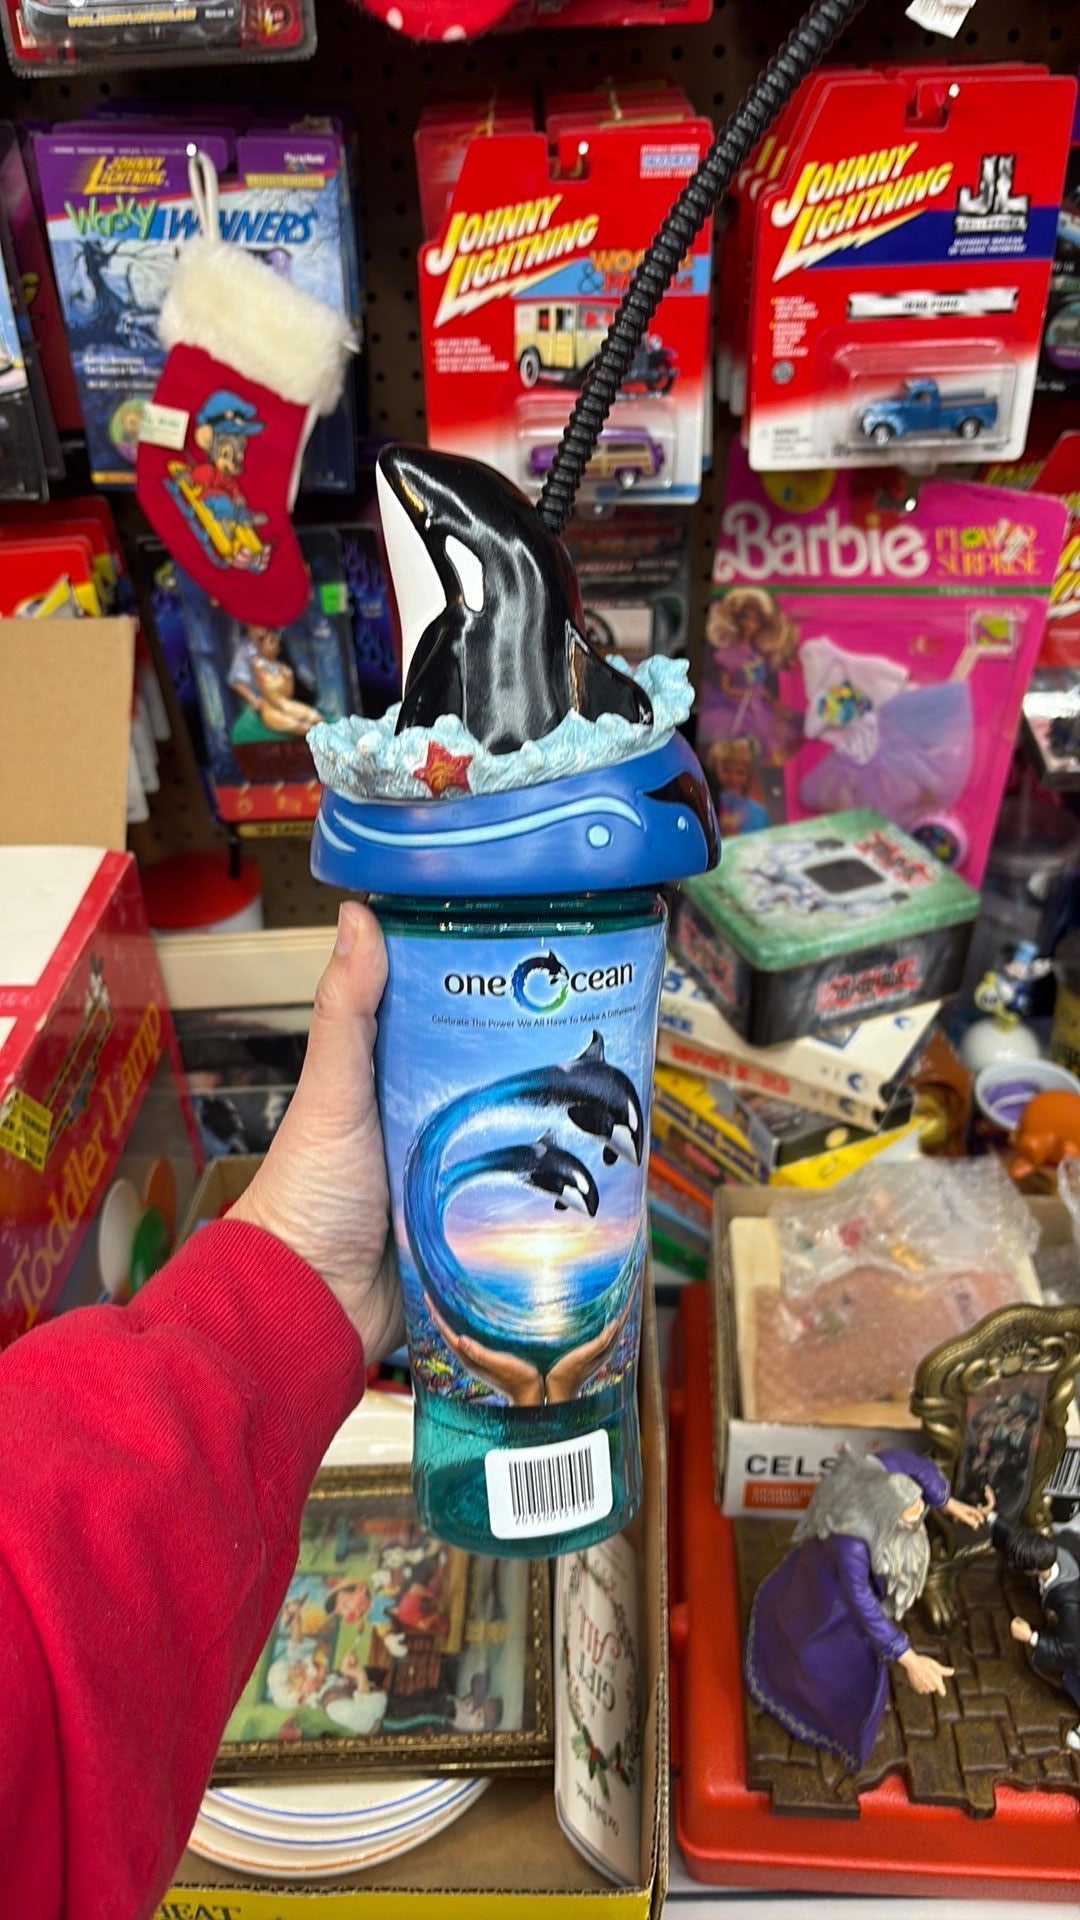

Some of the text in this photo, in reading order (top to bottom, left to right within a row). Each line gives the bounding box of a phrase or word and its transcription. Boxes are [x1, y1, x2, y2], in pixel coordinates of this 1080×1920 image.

[83, 155, 167, 195] LIGHTNING
[107, 156, 166, 171] JOHNNY
[771, 142, 919, 228] JOHNNY
[425, 194, 564, 276] JOHNNY
[772, 162, 954, 283] LIGHTNING
[432, 214, 600, 329] LIGHTNING
[577, 263, 599, 293] &
[714, 501, 930, 582] Barbie
[431, 1013, 470, 1026] Celebrate
[471, 1016, 487, 1028] The
[488, 1017, 515, 1029] Power
[517, 1018, 533, 1029] We
[533, 1017, 546, 1028] All
[546, 1016, 568, 1027] Have
[569, 1014, 579, 1026] To
[580, 1011, 601, 1024] Make
[444, 972, 507, 997] one
[6, 1117, 110, 1331] Toddler
[102, 1002, 162, 1139] Lamp
